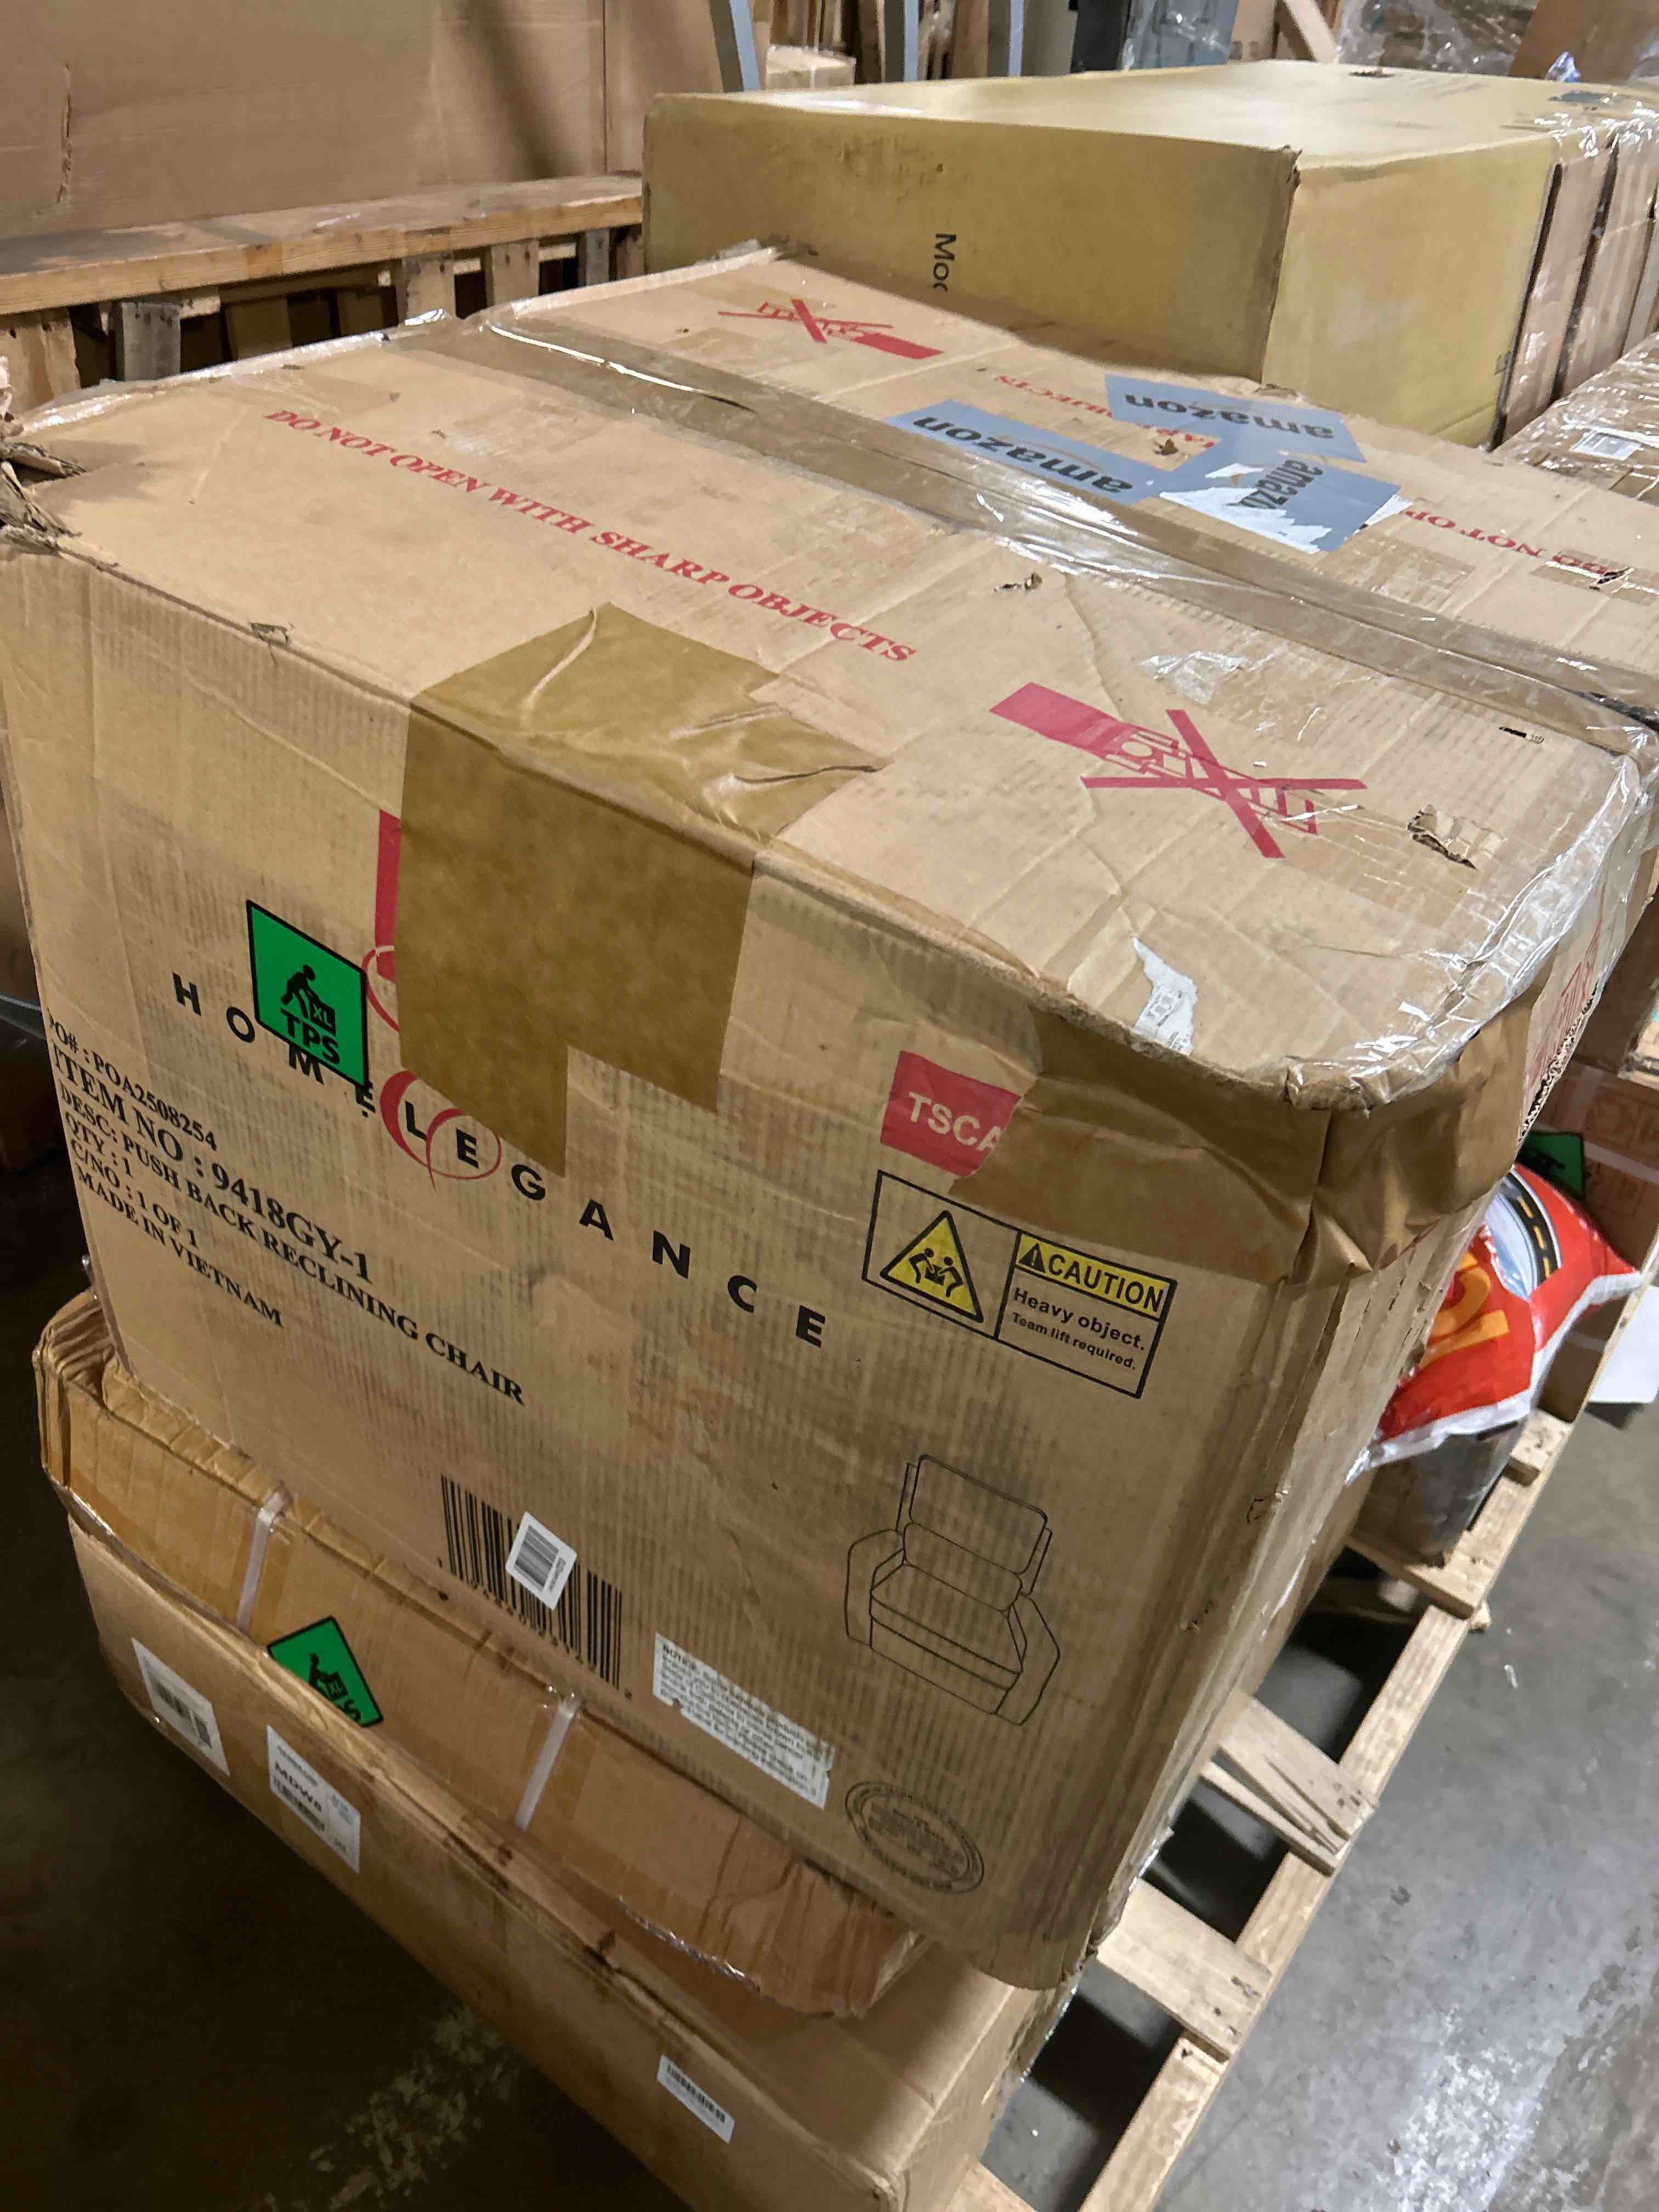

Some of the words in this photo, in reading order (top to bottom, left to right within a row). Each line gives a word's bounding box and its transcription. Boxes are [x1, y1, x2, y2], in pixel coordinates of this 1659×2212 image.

[1124, 393, 1335, 439] amazon
[912, 415, 1135, 494] amazon
[262, 409, 322, 431] DO
[314, 426, 398, 458] NOT
[390, 453, 493, 493] OPEN
[488, 486, 596, 535] WITH
[589, 529, 731, 585] SHARP
[727, 582, 918, 662] OBJECTS
[1458, 527, 1546, 558] NOT
[280, 1006, 341, 1064] TPS
[65, 1110, 105, 1156] QTY
[92, 1049, 217, 1152] POA2508254
[908, 1091, 1006, 1154] TSCA
[53, 1039, 129, 1125] ITEM
[132, 1105, 184, 1163] NO
[211, 1162, 373, 1285] 9418GY-1
[70, 1138, 120, 1189] C/NO
[137, 1189, 149, 1211] 1
[152, 1202, 182, 1236] OF
[187, 1227, 200, 1250] 1
[75, 1160, 139, 1226] MADE
[141, 1214, 167, 1246] IN
[169, 1234, 285, 1330] VIETNAM
[120, 1130, 182, 1191] PUSH
[184, 1177, 257, 1240] BACK
[262, 1227, 420, 1341] RECLINING
[425, 1331, 526, 1407] CHAIR
[1047, 1252, 1165, 1313] CAUTION
[1012, 1311, 1048, 1335] Team
[1049, 1325, 1070, 1344] lift
[1072, 1338, 1136, 1370] required.
[1013, 1286, 1075, 1324] Heavy
[1077, 1316, 1146, 1351] object.
